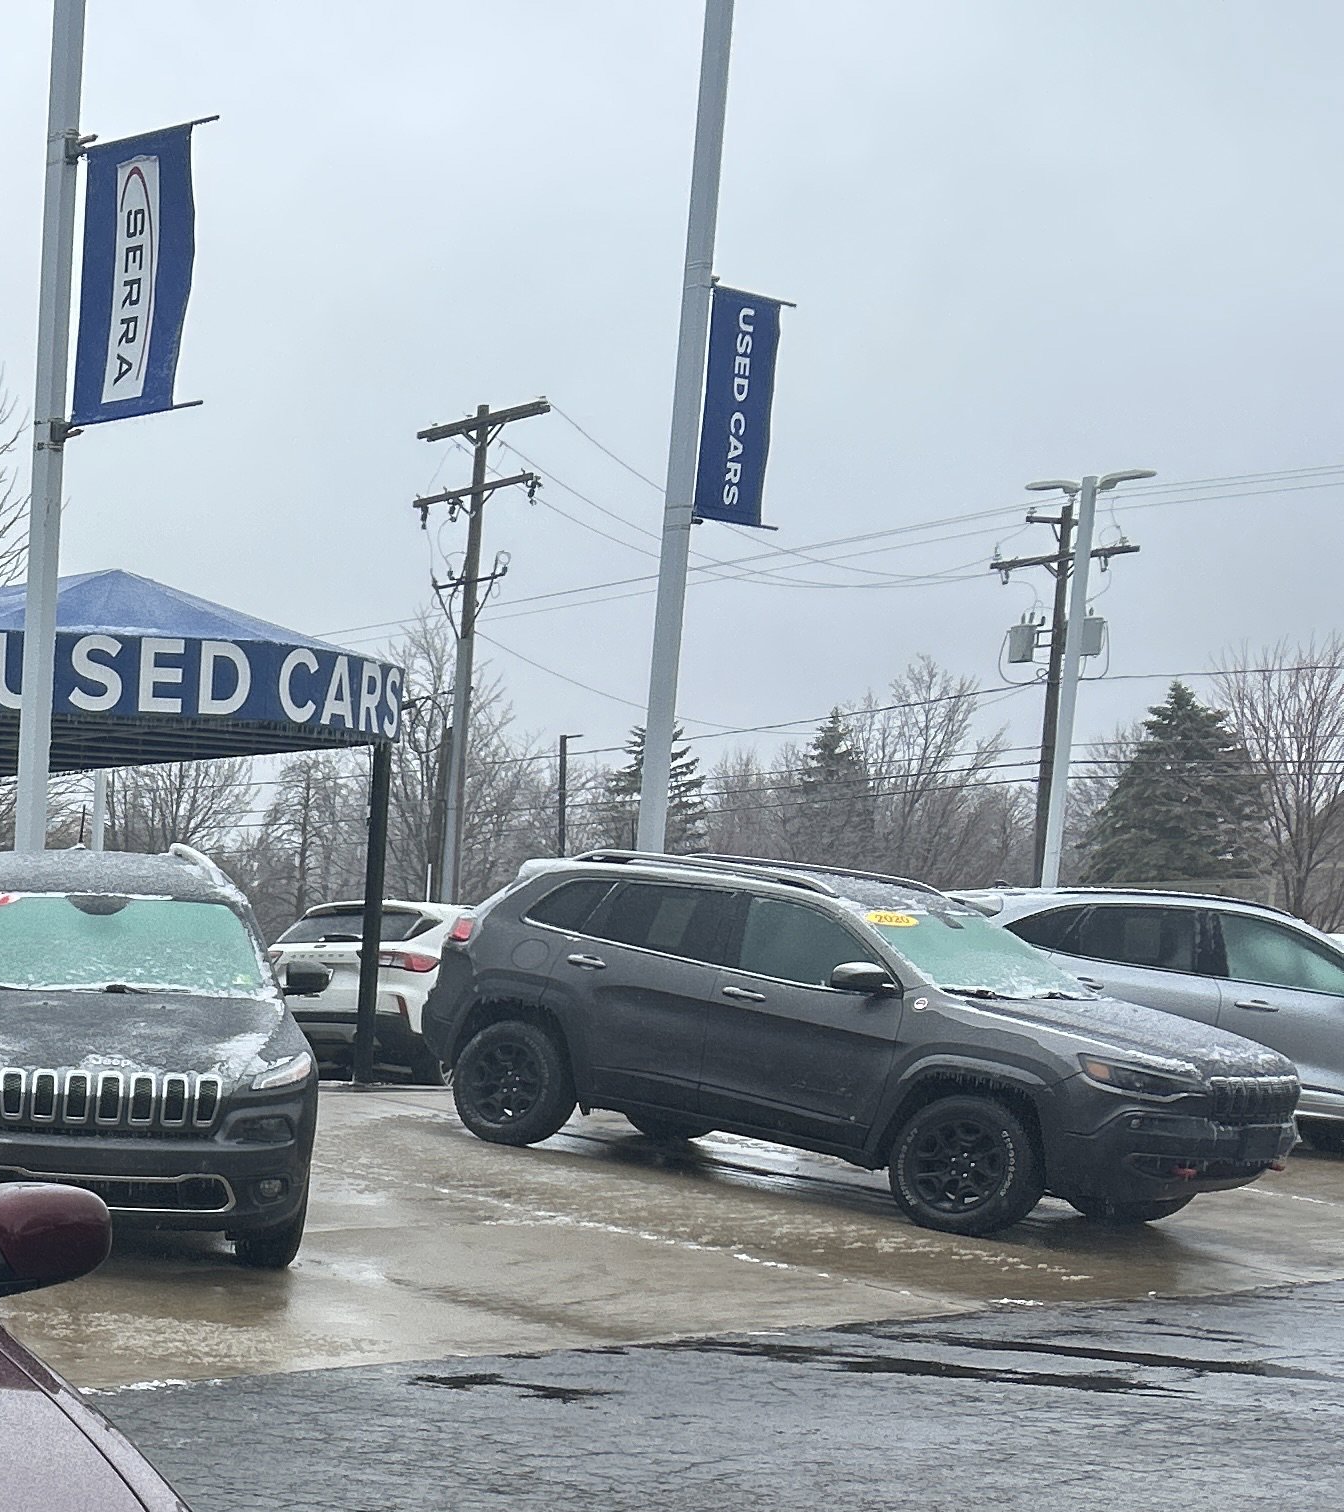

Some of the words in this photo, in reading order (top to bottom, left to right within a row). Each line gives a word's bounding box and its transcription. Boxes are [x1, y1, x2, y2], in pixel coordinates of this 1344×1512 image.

[113, 207, 145, 387] SERRA
[733, 307, 755, 402] USED
[722, 411, 746, 506] CARS
[277, 647, 402, 740] CARS
[875, 914, 909, 923] 2020
